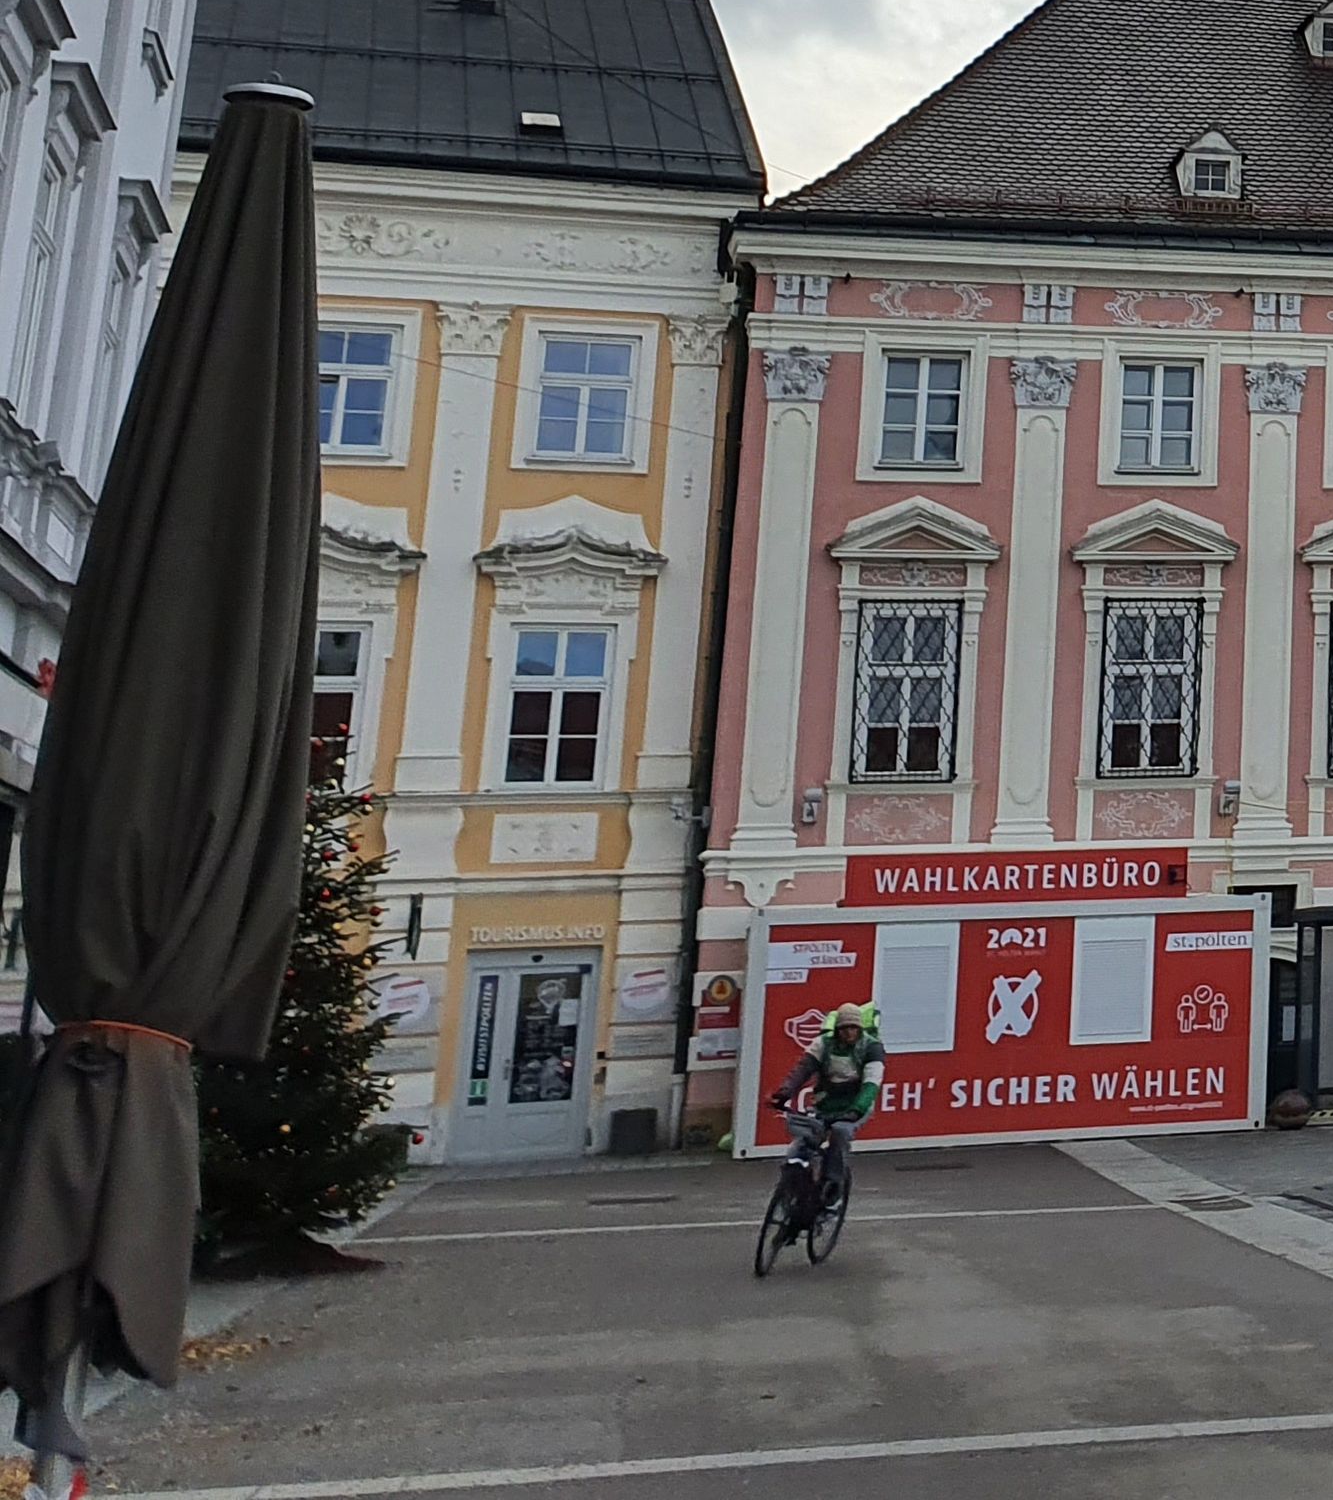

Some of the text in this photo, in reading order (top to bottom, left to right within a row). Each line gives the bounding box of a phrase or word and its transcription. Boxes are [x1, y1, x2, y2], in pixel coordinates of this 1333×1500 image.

[874, 857, 1161, 894] WAHLKARTENBÜRO
[987, 927, 1047, 949] 2021
[881, 1065, 1224, 1112] EH' SICHER WÄHLEN
